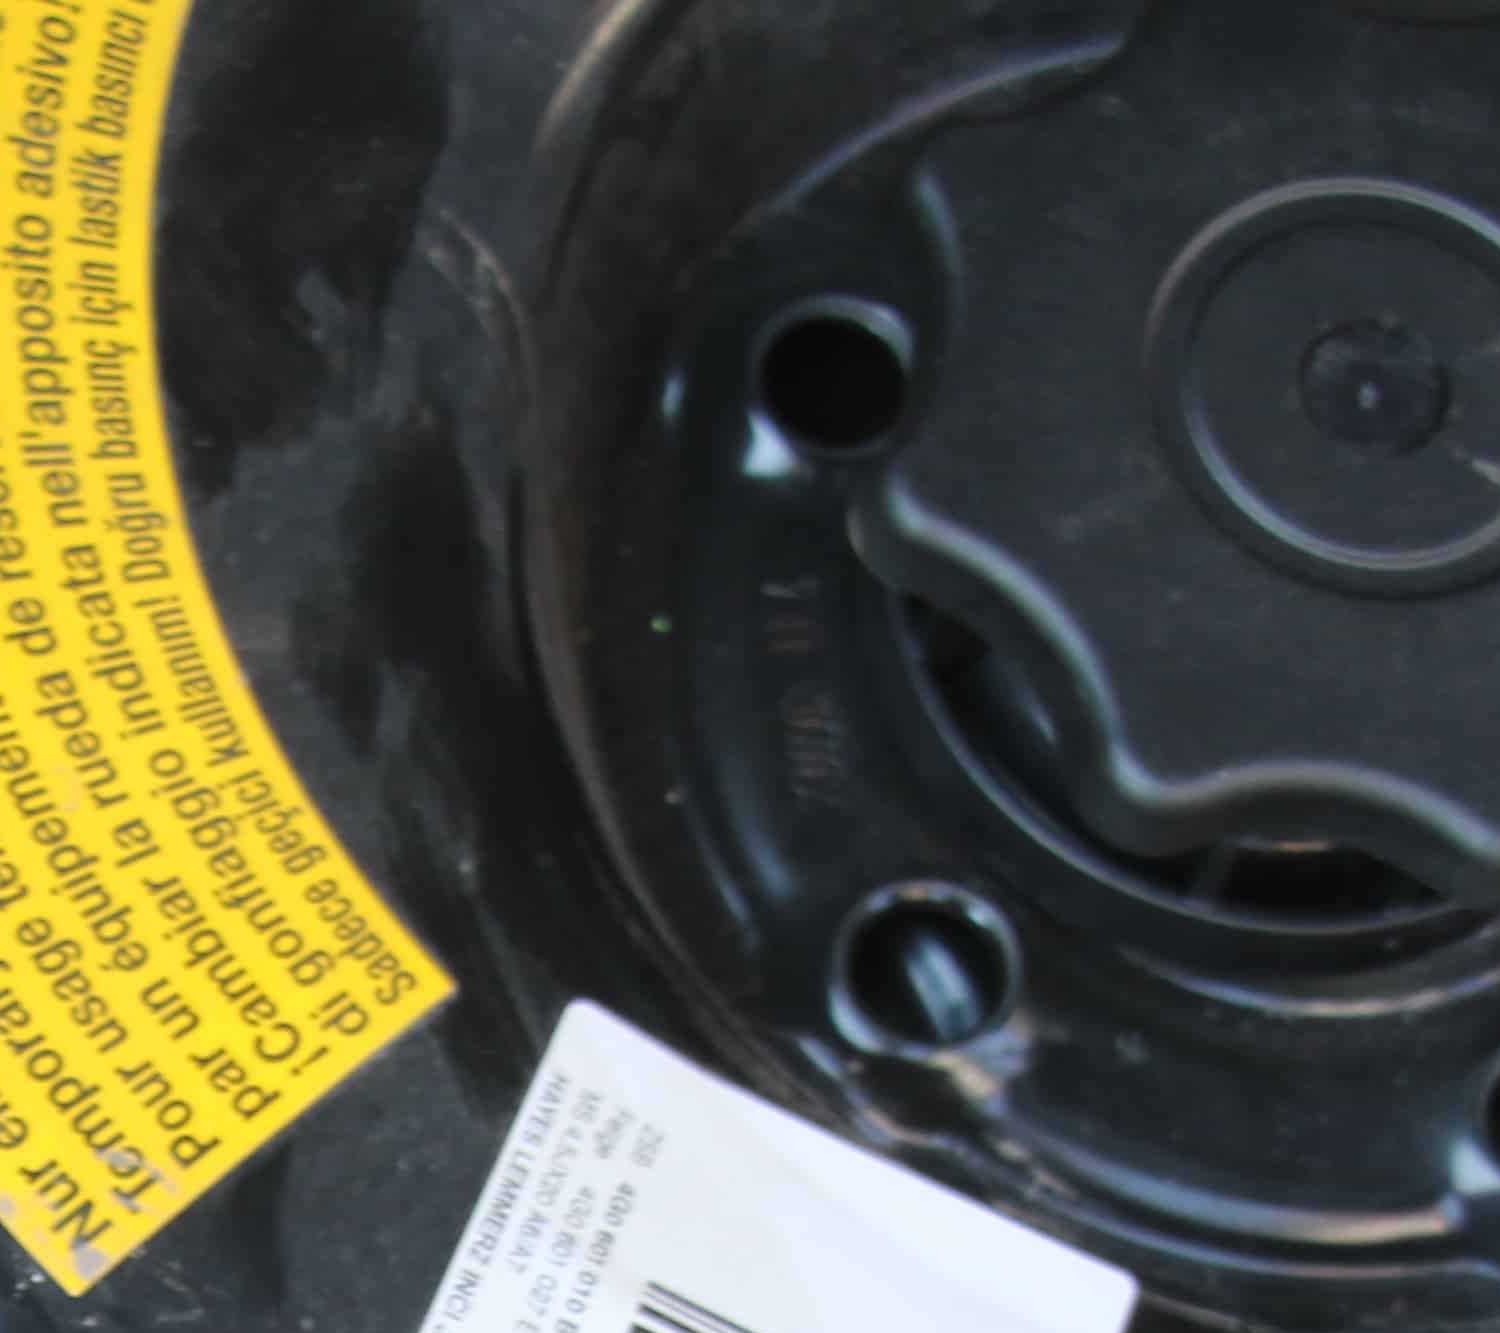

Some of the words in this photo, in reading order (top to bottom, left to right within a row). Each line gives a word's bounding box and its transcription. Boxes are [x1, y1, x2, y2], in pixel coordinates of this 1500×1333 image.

[66, 147, 124, 250] lastik
[66, 259, 134, 327] için
[0, 212, 90, 528] nell'apposito
[103, 470, 172, 584] Doğru
[2, 597, 58, 657] de
[59, 542, 166, 740] indicata
[34, 668, 129, 809] rueda
[111, 816, 161, 868] la
[147, 747, 337, 988] gonfiaggio
[14, 915, 129, 1054] usage
[302, 877, 419, 1007] Sadece
[139, 976, 201, 1041] un
[309, 990, 371, 1037] di
[113, 1059, 222, 1169] Pour
[187, 1046, 282, 1121] par
[17, 1158, 113, 1254] Nur
[465, 1147, 536, 1268] LEMMERZ
